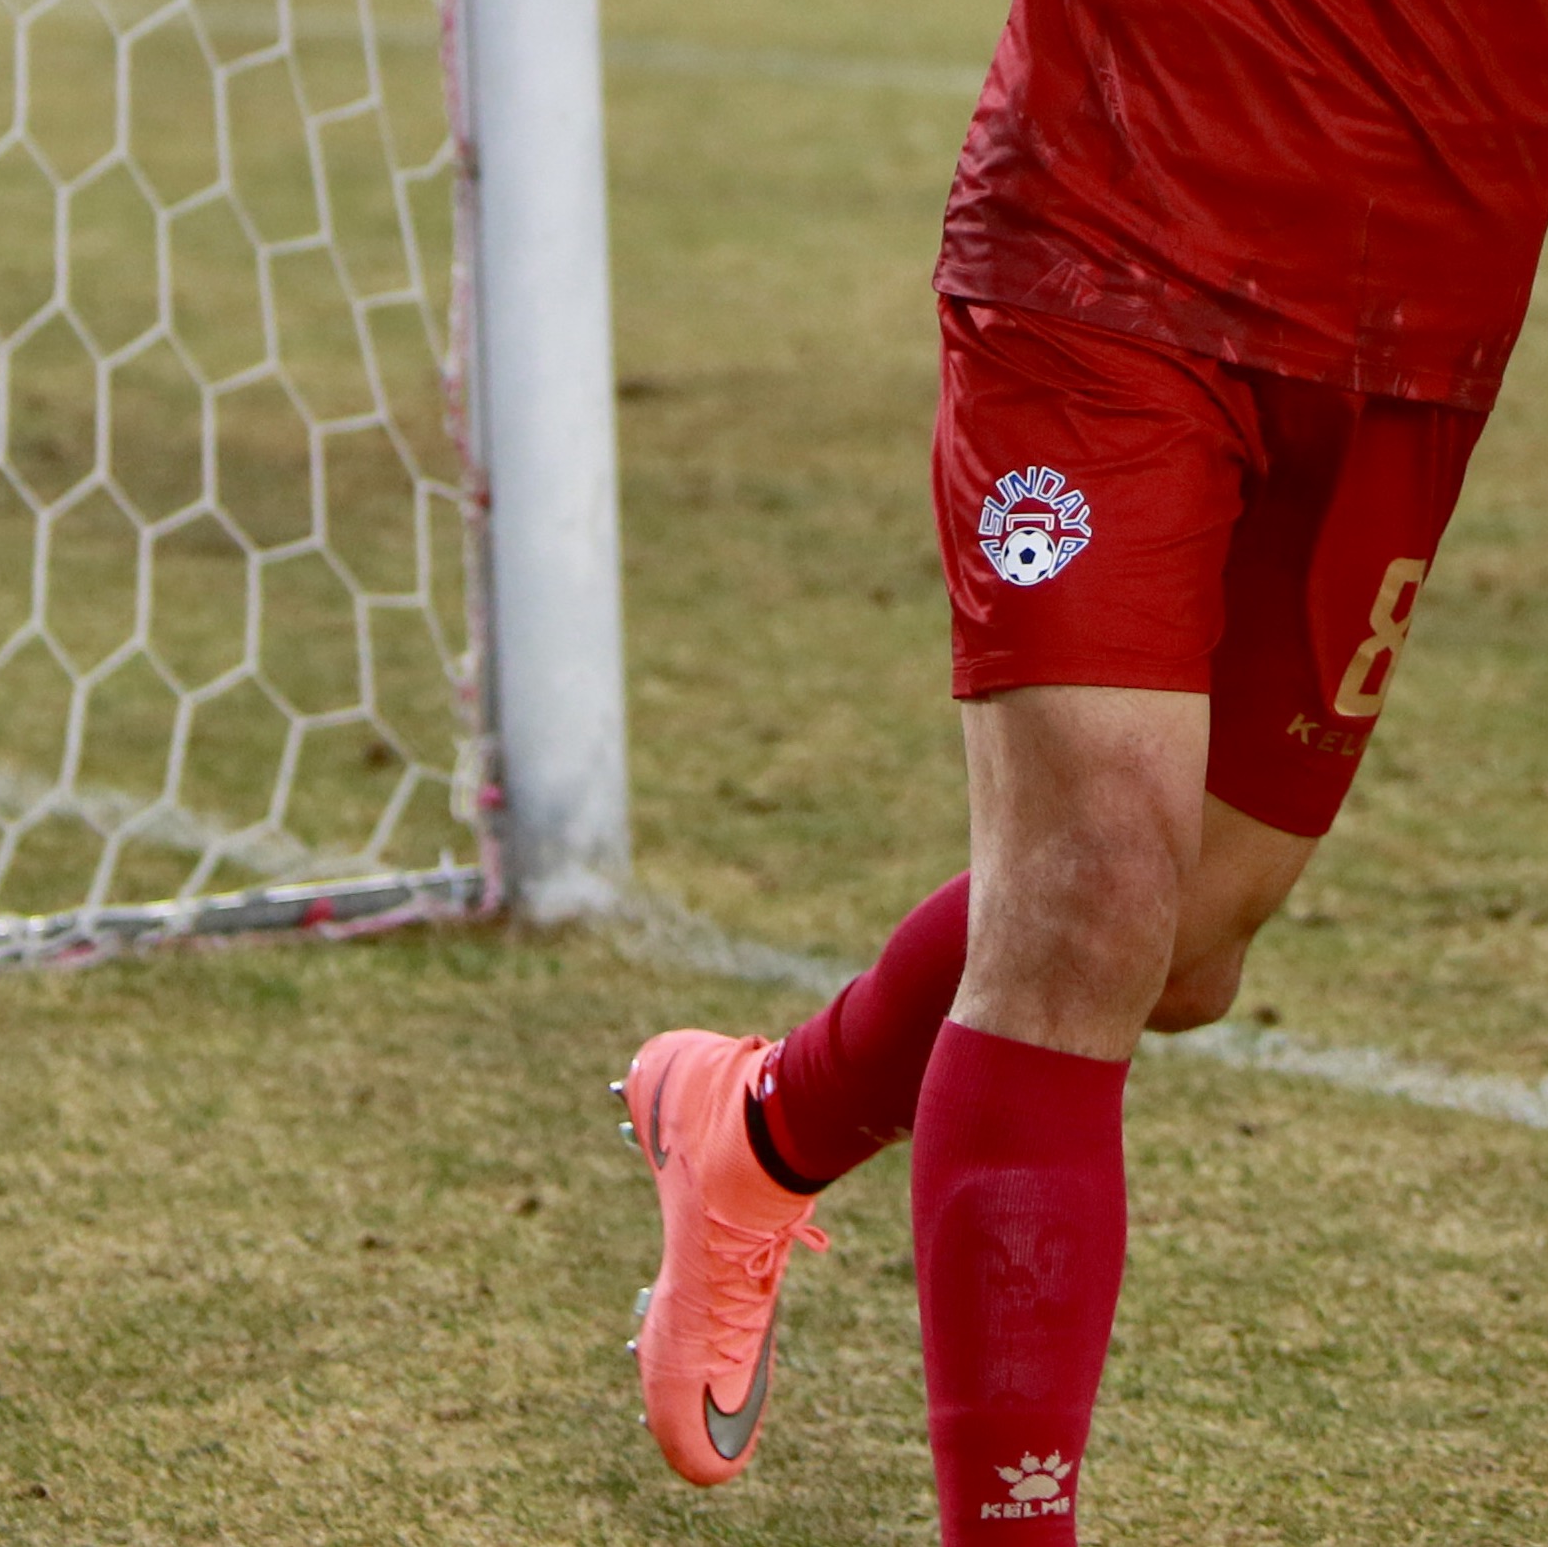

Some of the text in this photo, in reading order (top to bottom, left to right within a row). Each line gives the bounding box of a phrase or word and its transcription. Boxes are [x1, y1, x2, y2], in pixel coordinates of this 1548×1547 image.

[978, 466, 1092, 537] SUNDAY
[1334, 557, 1428, 717] 8
[1286, 712, 1372, 756] KEL
